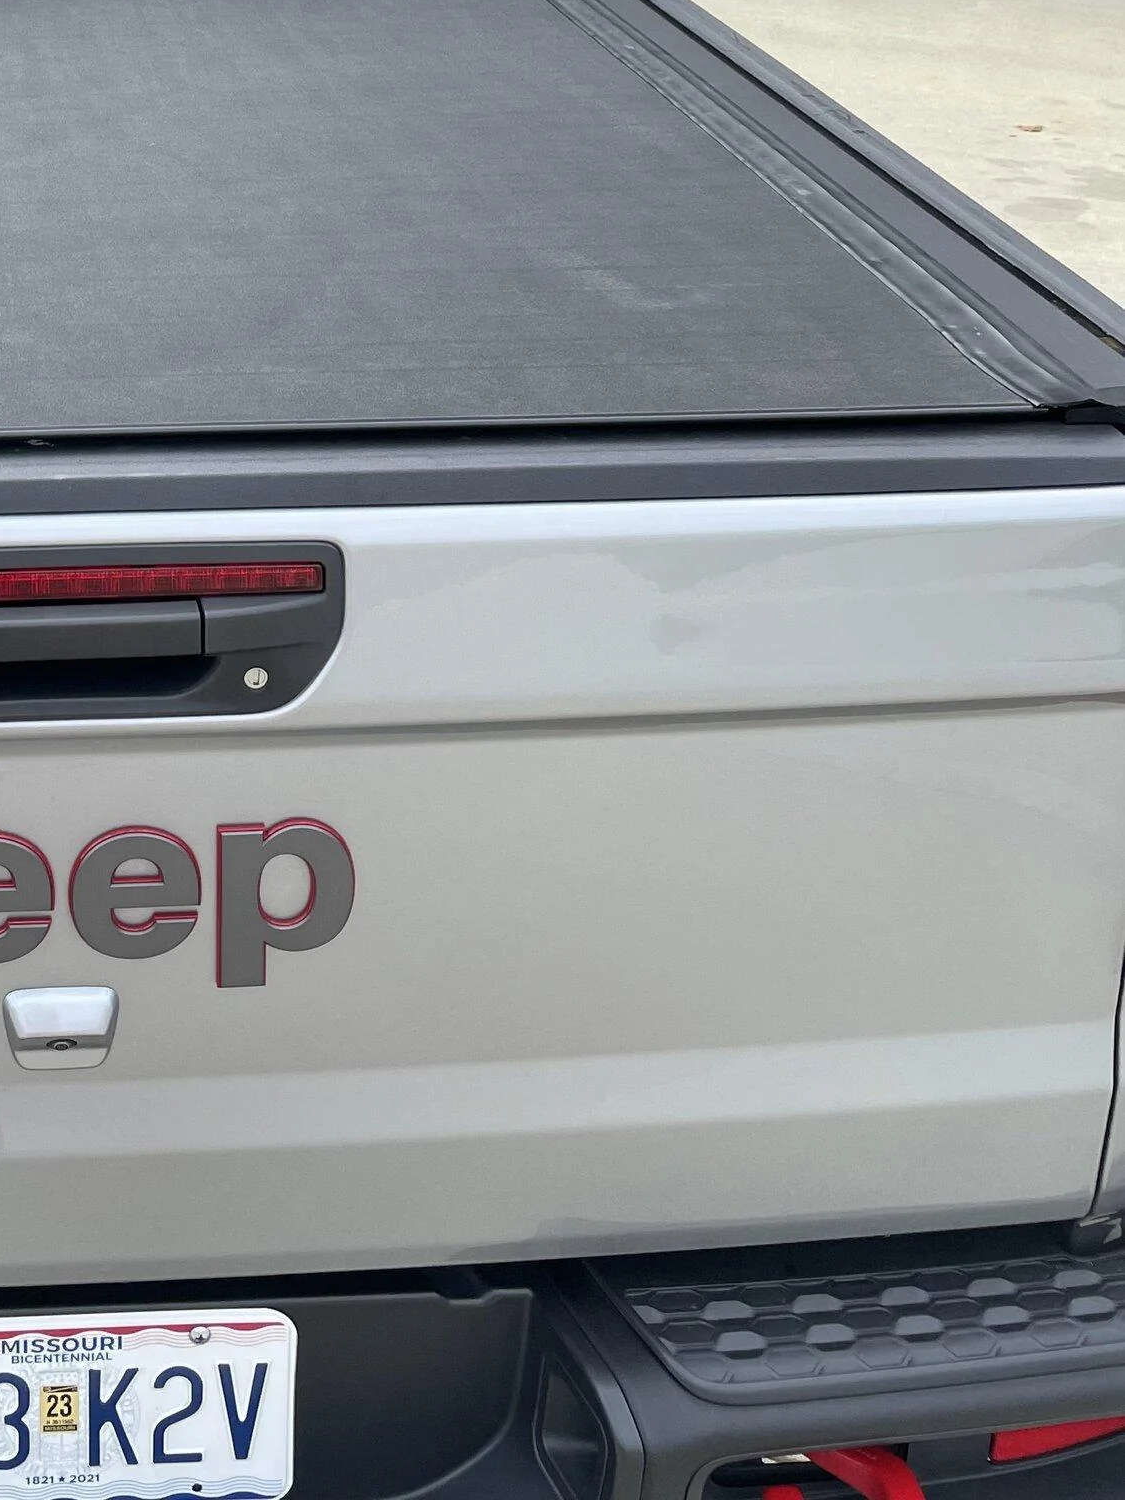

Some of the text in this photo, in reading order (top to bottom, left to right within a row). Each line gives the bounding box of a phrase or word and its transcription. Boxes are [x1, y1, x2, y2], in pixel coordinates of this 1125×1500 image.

[1, 1335, 123, 1355] MISSOURI
[11, 1352, 113, 1365] BICENTENNIAL
[47, 1394, 72, 1417] 23
[87, 1363, 269, 1467] K2V
[25, 1474, 100, 1485] 1821 2021
